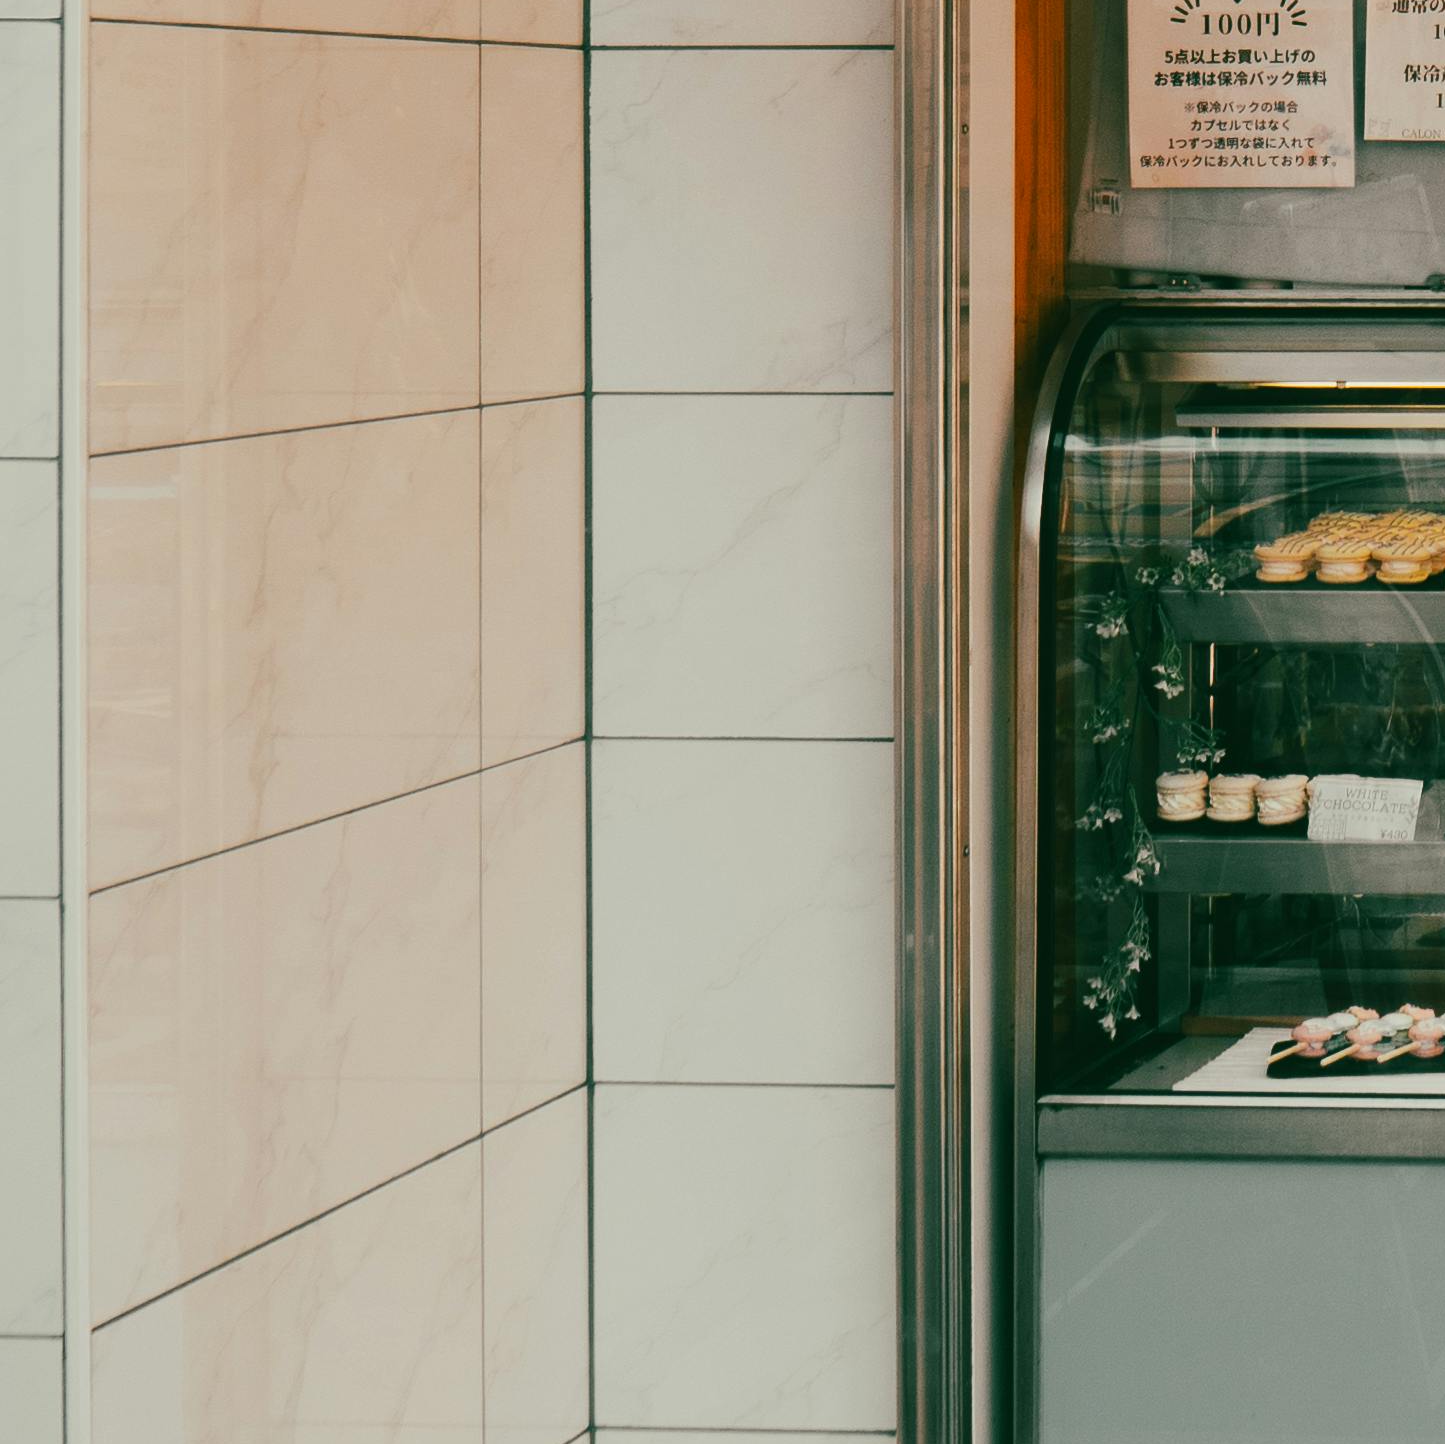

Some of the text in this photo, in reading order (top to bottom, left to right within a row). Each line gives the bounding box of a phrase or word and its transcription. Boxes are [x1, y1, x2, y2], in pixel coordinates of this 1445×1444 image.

[1201, 12, 1280, 36] 100円
[1164, 48, 1316, 65] 5点以上お買い上げの
[1153, 71, 1327, 87] お客様は保冷バック無料
[1401, 128, 1442, 139] CALON
[1168, 137, 1315, 150] 1つずつ透明な袋に入れて
[1346, 788, 1389, 801] WHITE
[1324, 799, 1408, 814] CHOCOLATE
